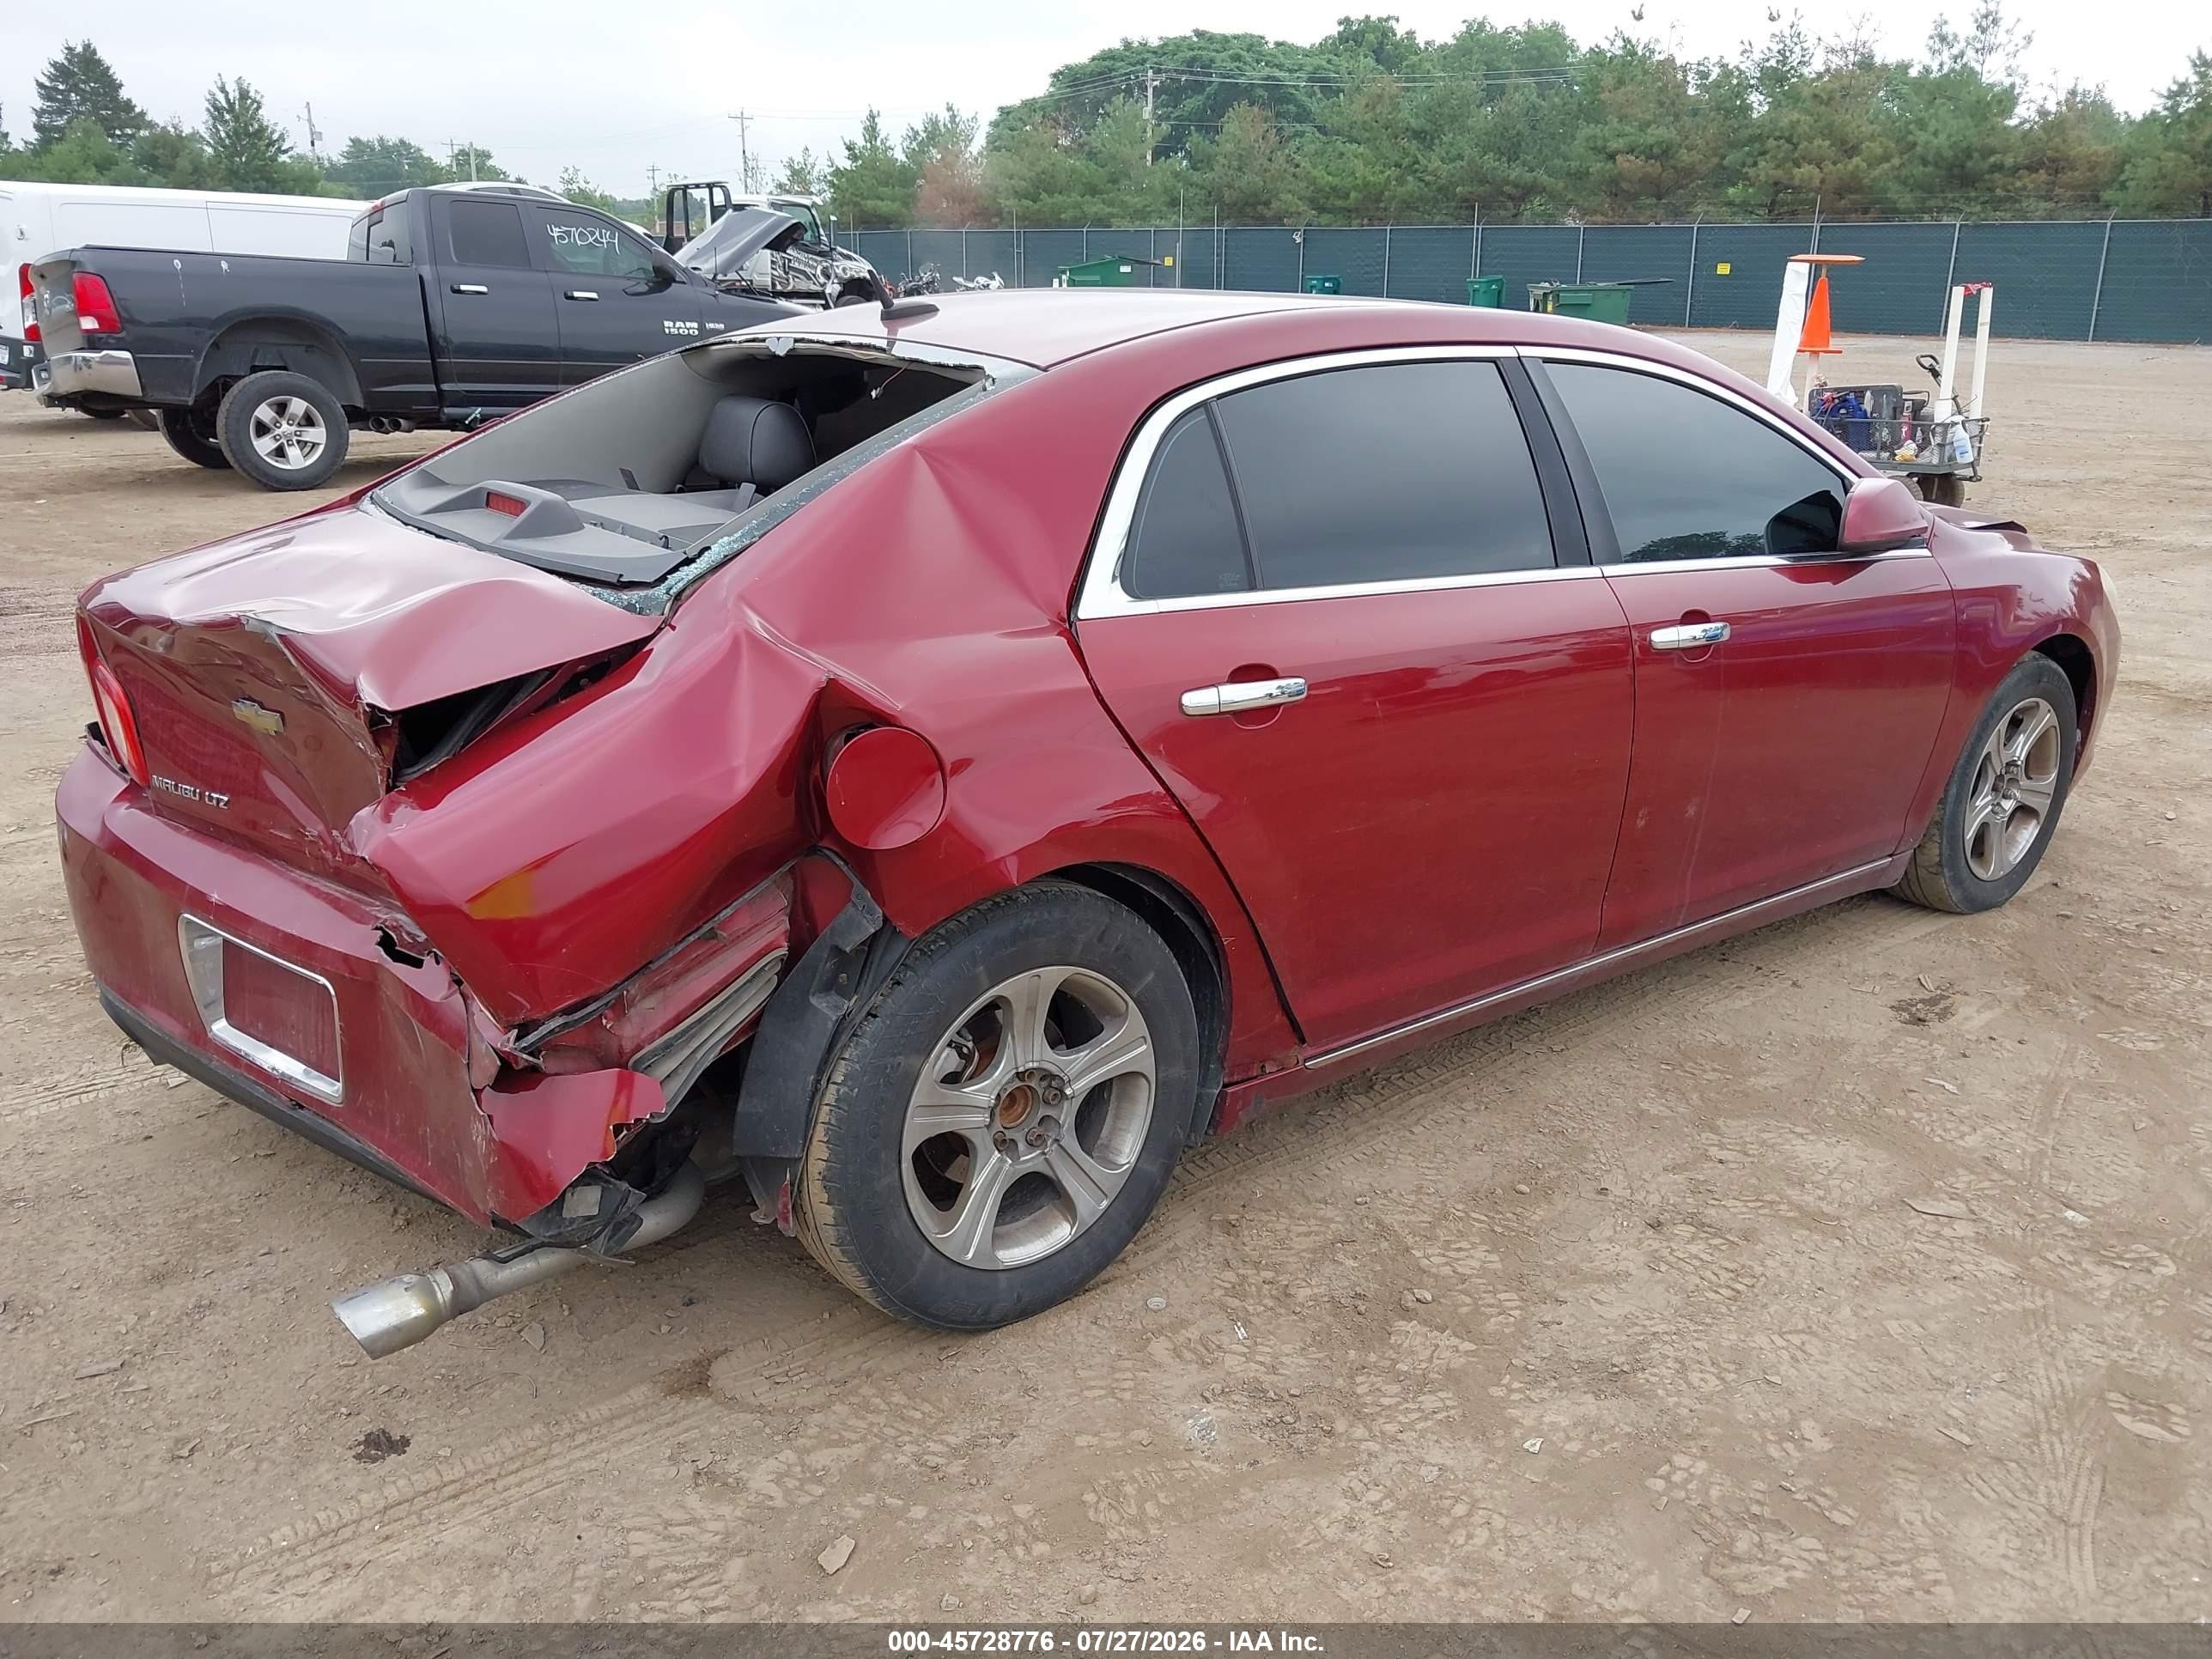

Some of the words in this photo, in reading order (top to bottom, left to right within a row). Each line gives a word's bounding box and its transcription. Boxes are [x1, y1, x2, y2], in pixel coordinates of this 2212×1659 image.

[663, 320, 698, 329] RAM
[151, 775, 200, 801] MALIBU
[204, 791, 230, 810] LTZ
